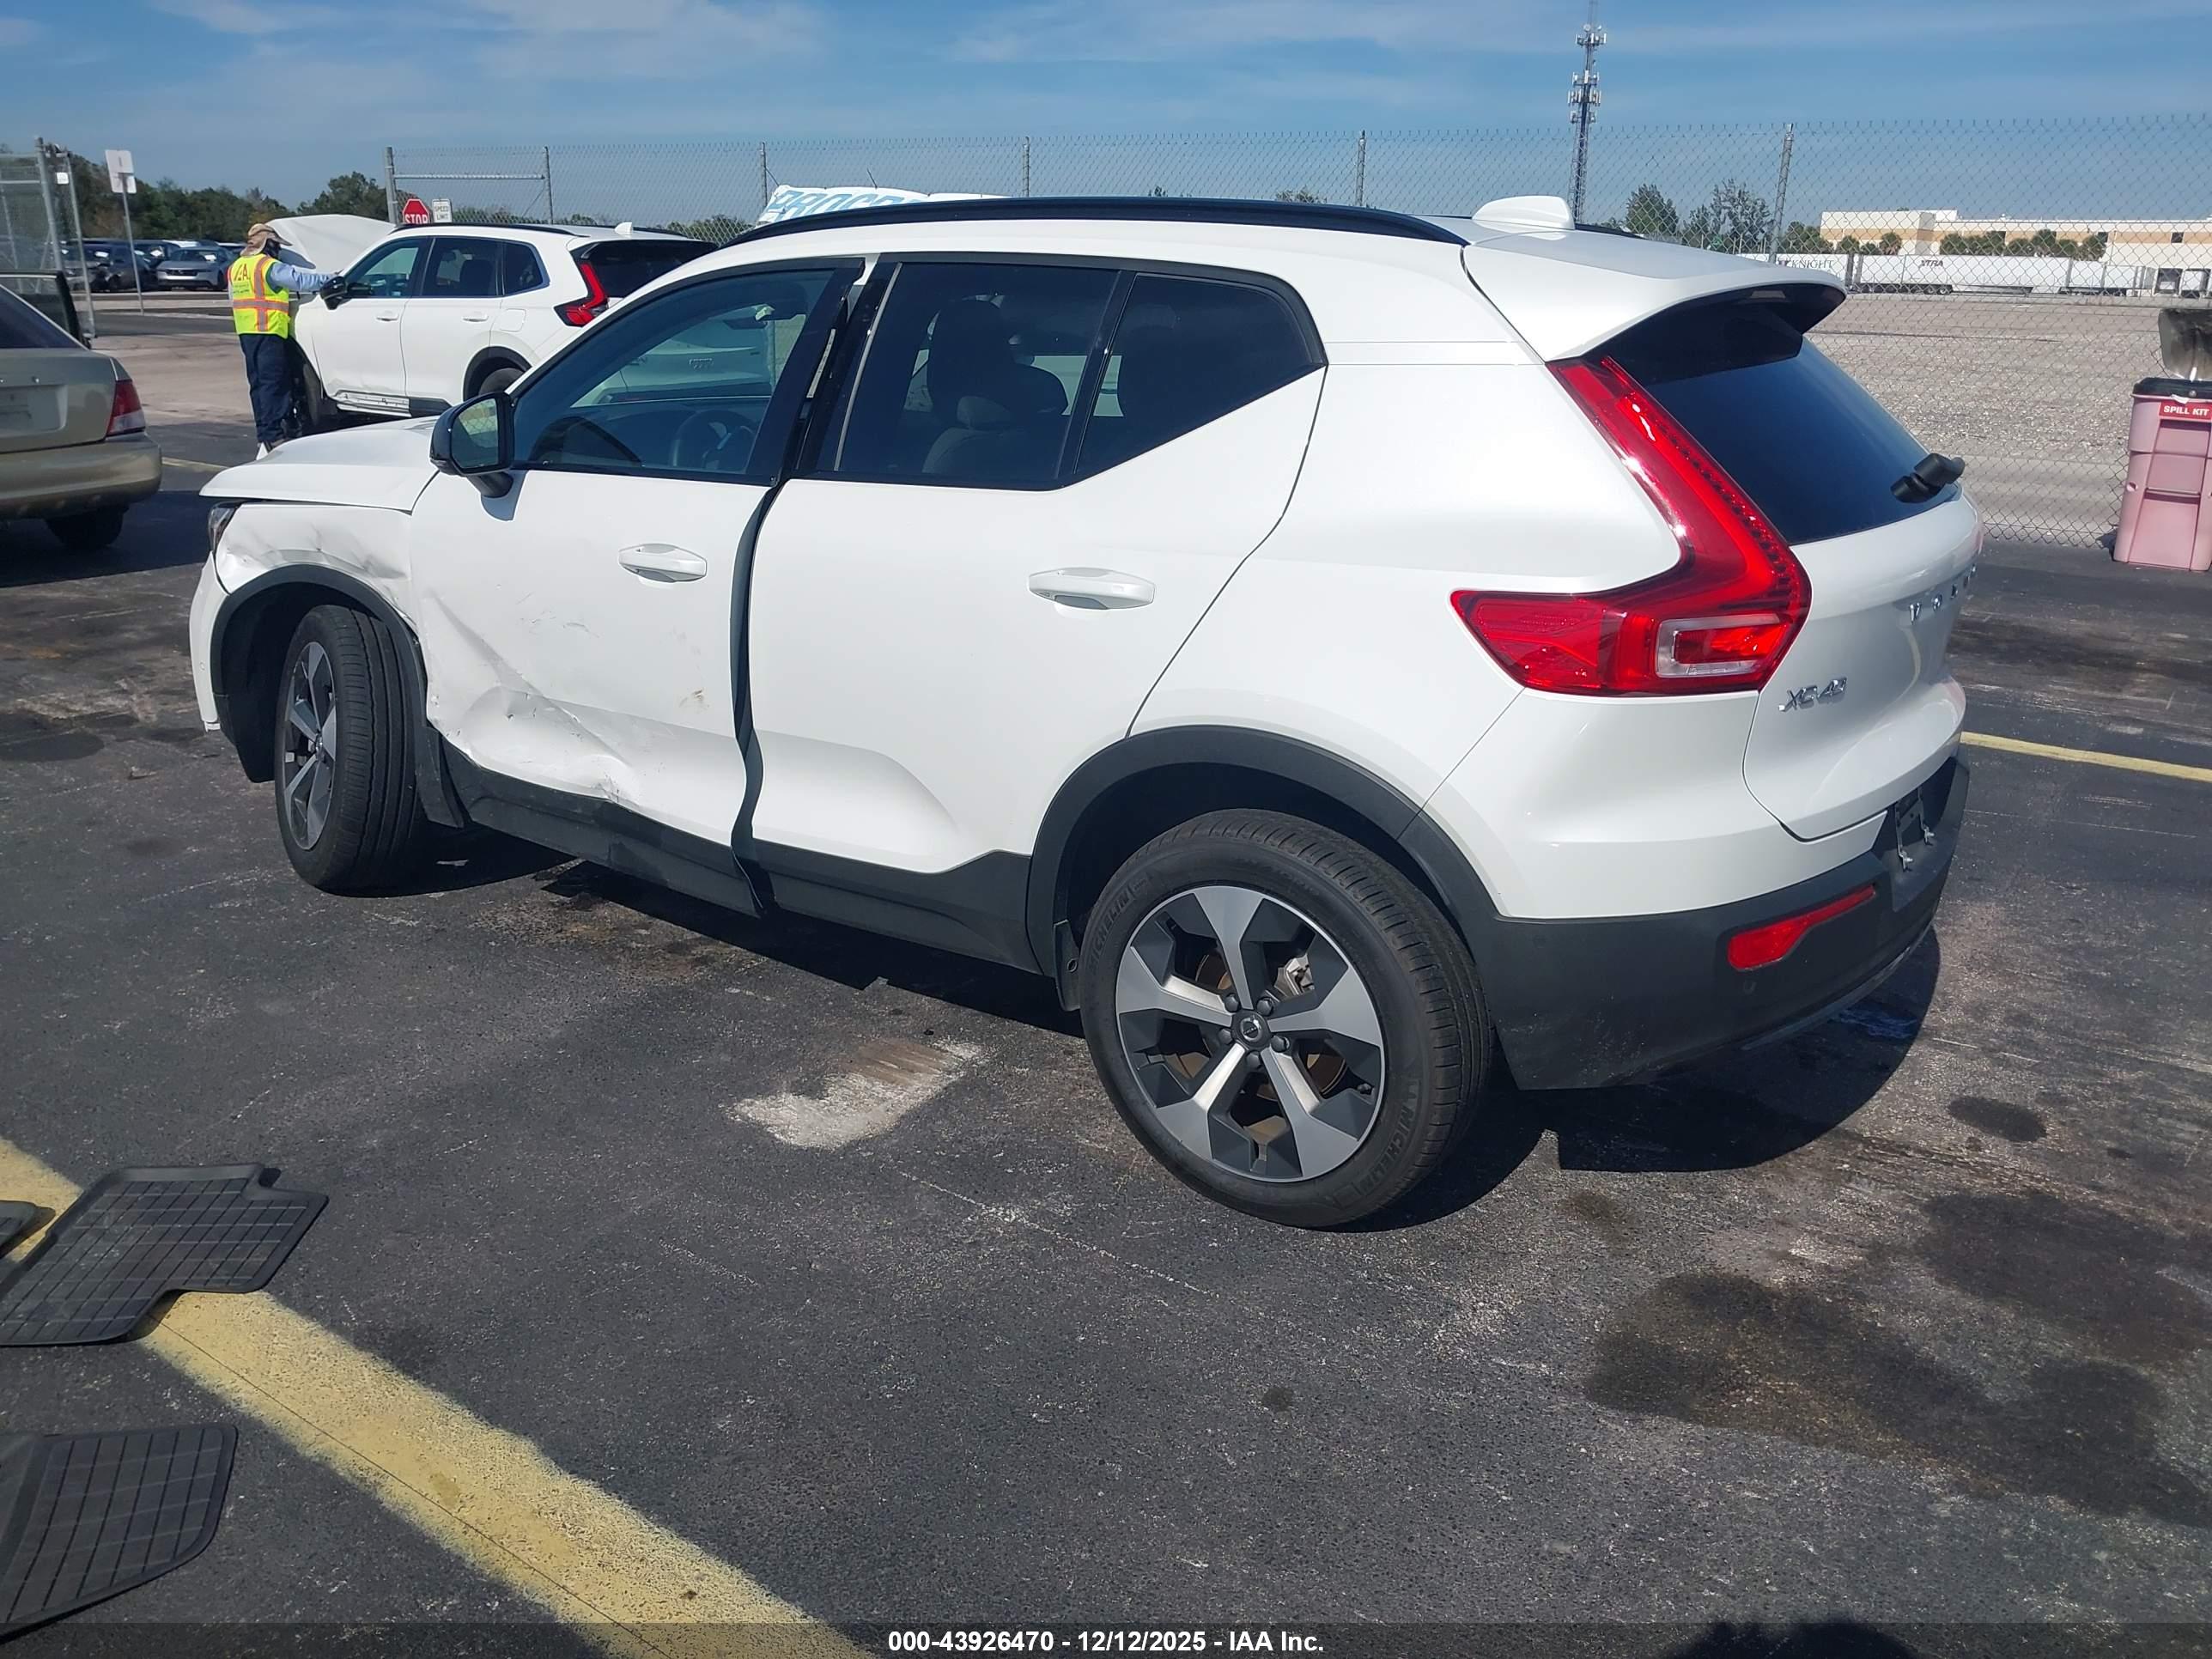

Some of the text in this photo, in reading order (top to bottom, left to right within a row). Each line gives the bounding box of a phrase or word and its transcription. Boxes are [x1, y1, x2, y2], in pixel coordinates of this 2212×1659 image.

[404, 213, 428, 224] STOP
[1791, 259, 1834, 269] KNIGHT
[2163, 404, 2210, 416] SPILL KIT
